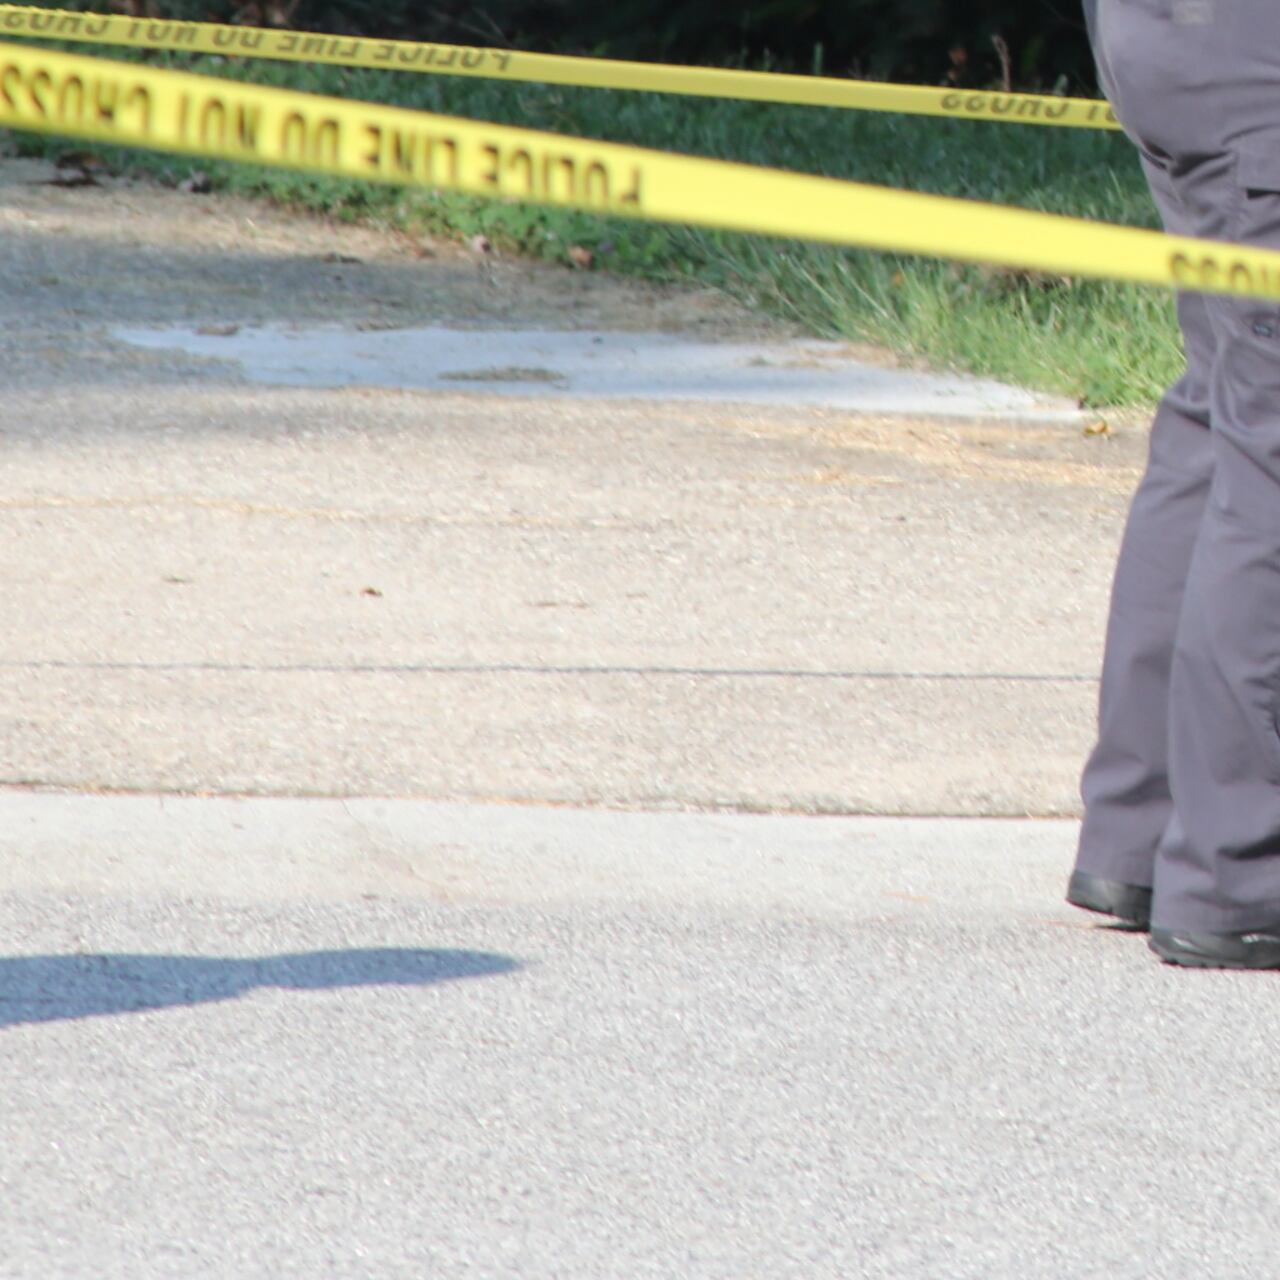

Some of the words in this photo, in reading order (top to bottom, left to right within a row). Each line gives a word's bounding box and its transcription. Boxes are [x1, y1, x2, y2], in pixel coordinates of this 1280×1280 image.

[0, 65, 152, 131] CROSS
[176, 89, 264, 149] NOT
[281, 109, 341, 162] DO
[358, 123, 458, 184] LINE
[480, 143, 642, 204] POLICE
